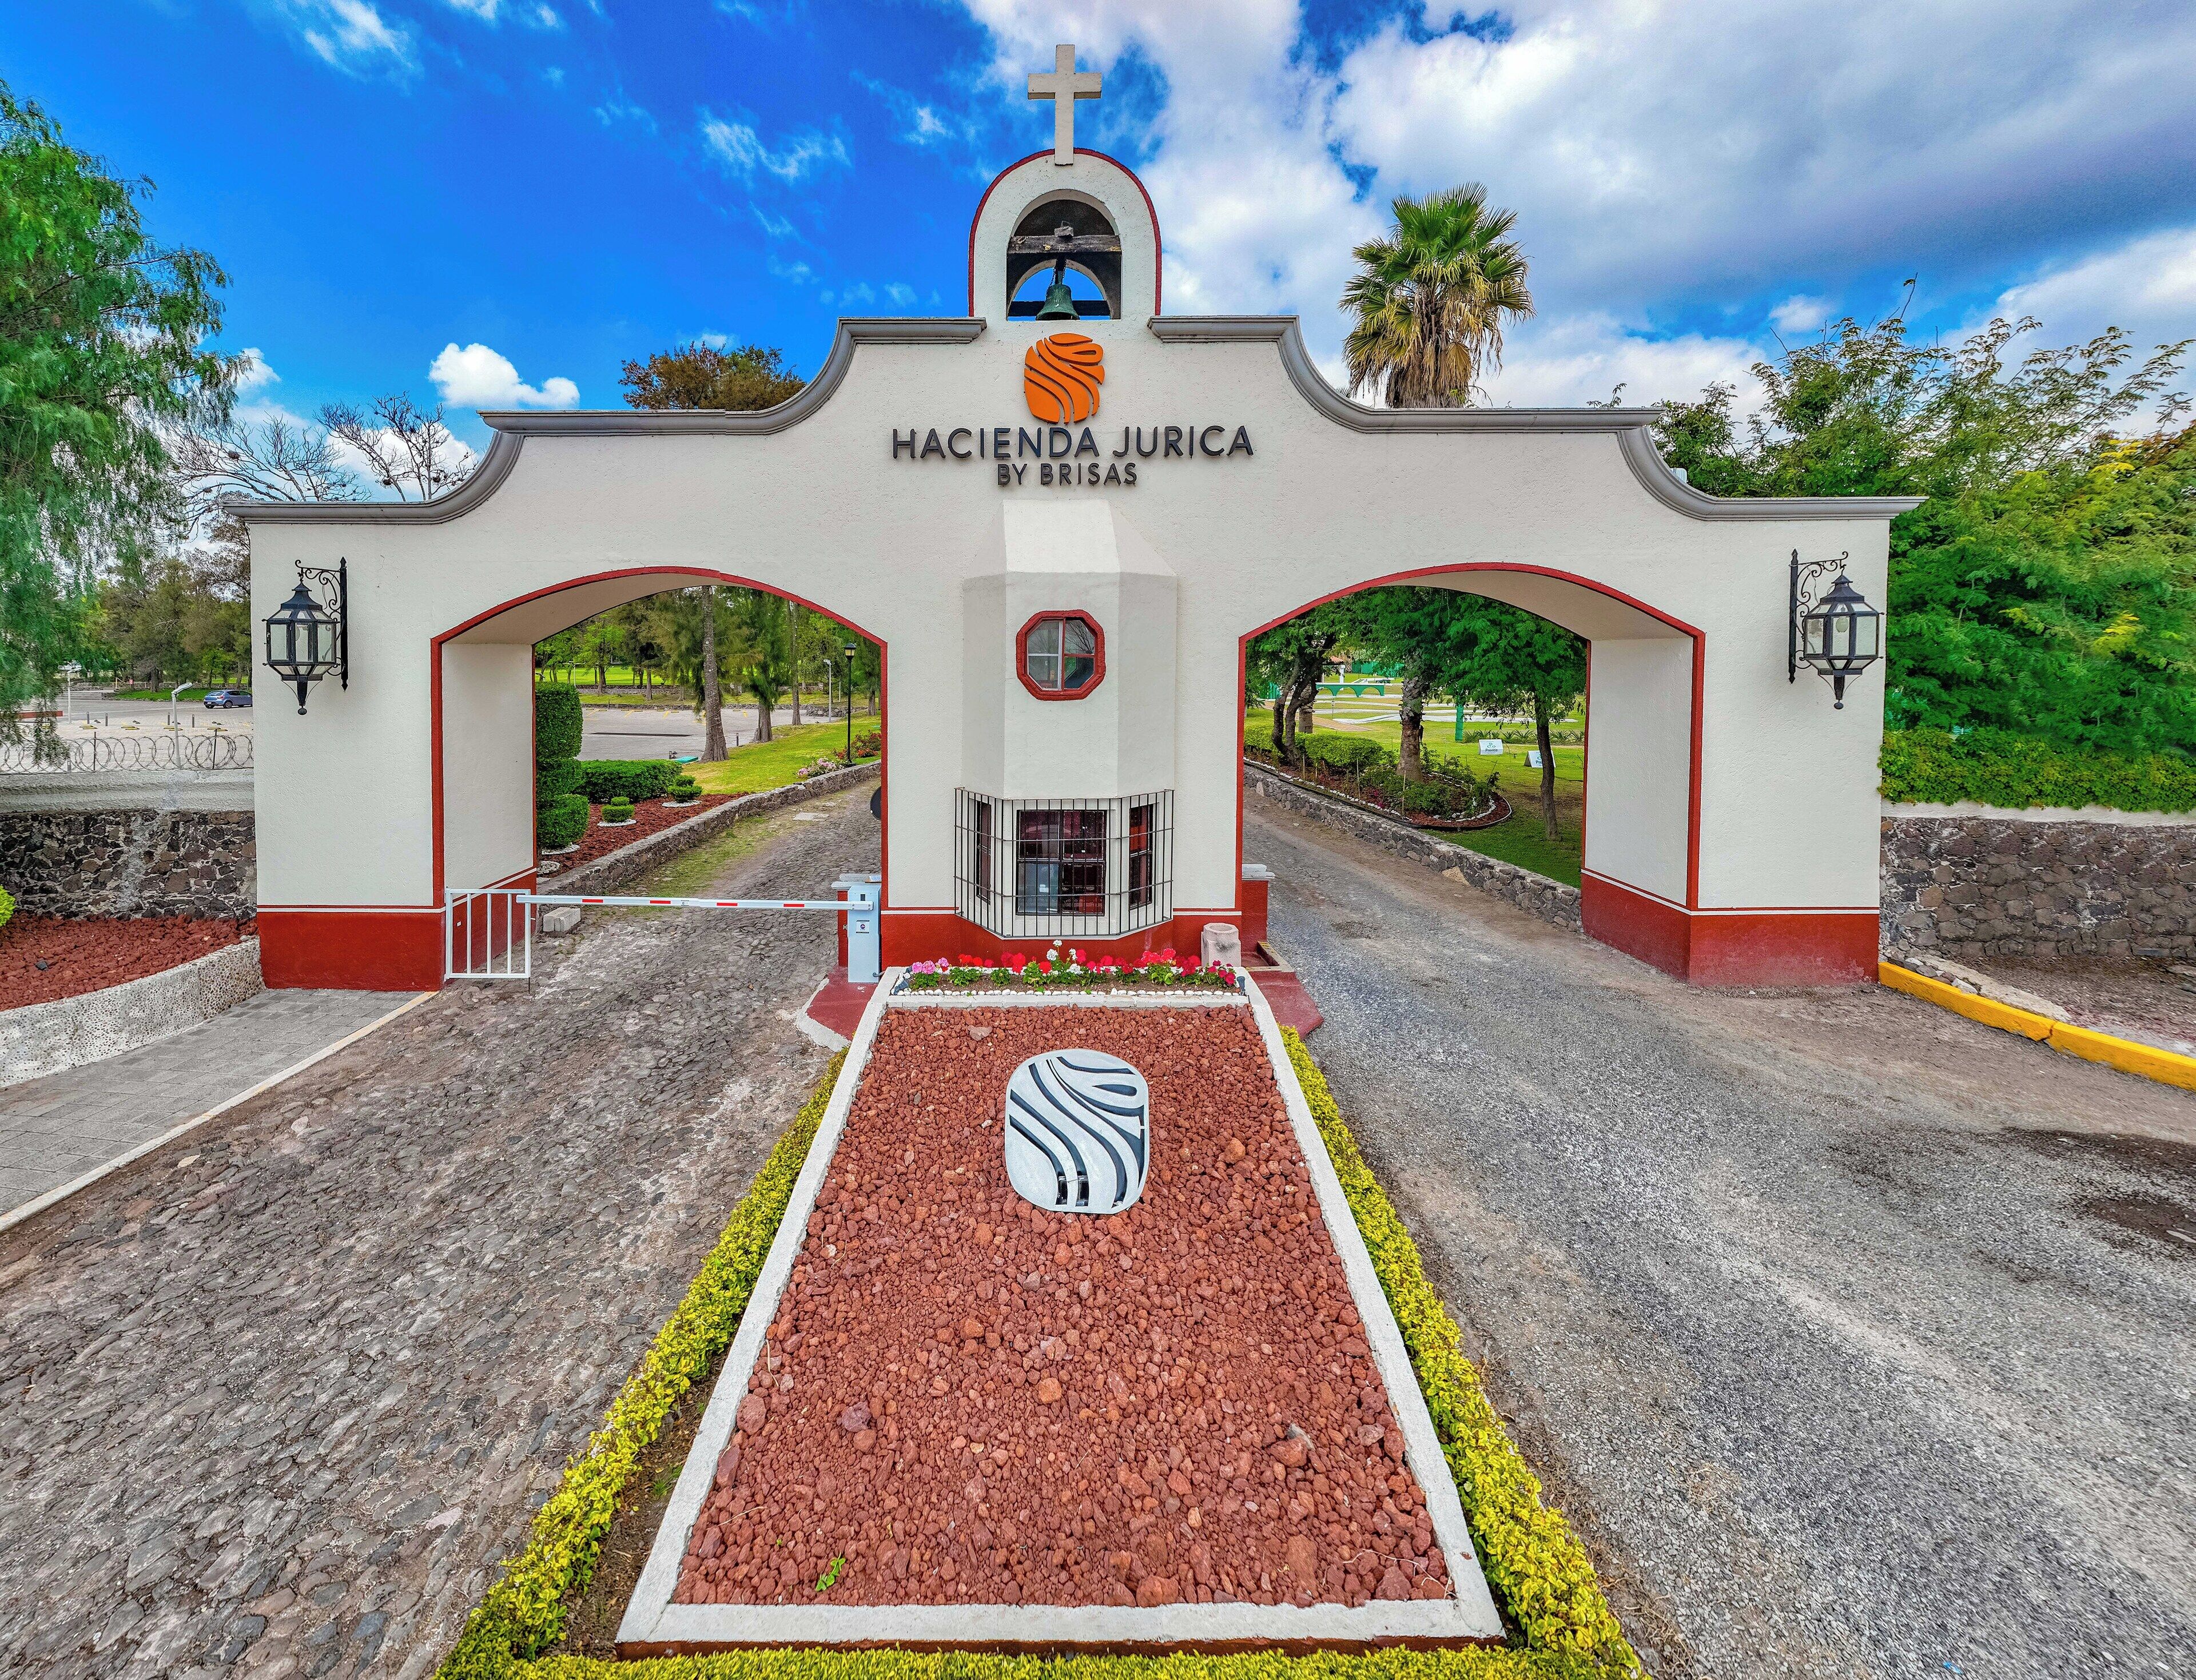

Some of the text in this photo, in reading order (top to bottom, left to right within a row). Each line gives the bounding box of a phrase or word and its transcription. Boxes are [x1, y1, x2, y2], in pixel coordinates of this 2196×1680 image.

[893, 425, 1254, 459] HACIENDA JURICA
[997, 462, 1137, 485] BY BRISAS
